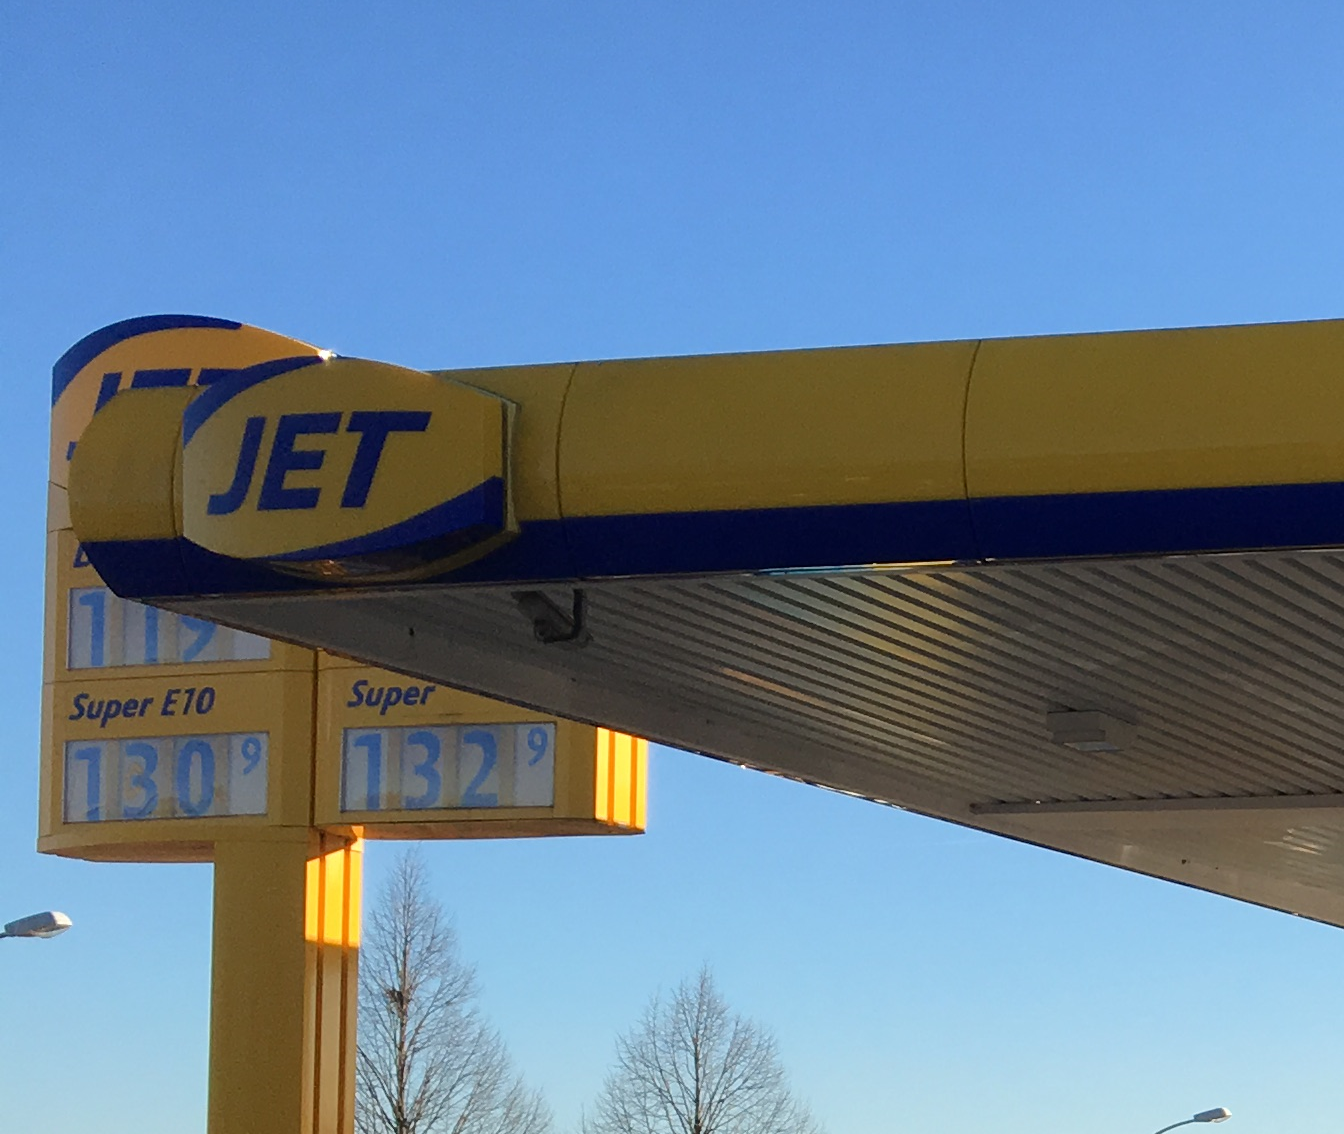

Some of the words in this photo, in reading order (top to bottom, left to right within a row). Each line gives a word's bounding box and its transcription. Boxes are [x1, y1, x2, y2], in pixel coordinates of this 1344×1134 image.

[207, 411, 432, 515] JET
[68, 691, 154, 728] Super
[160, 686, 216, 717] E10
[347, 679, 436, 715] Super
